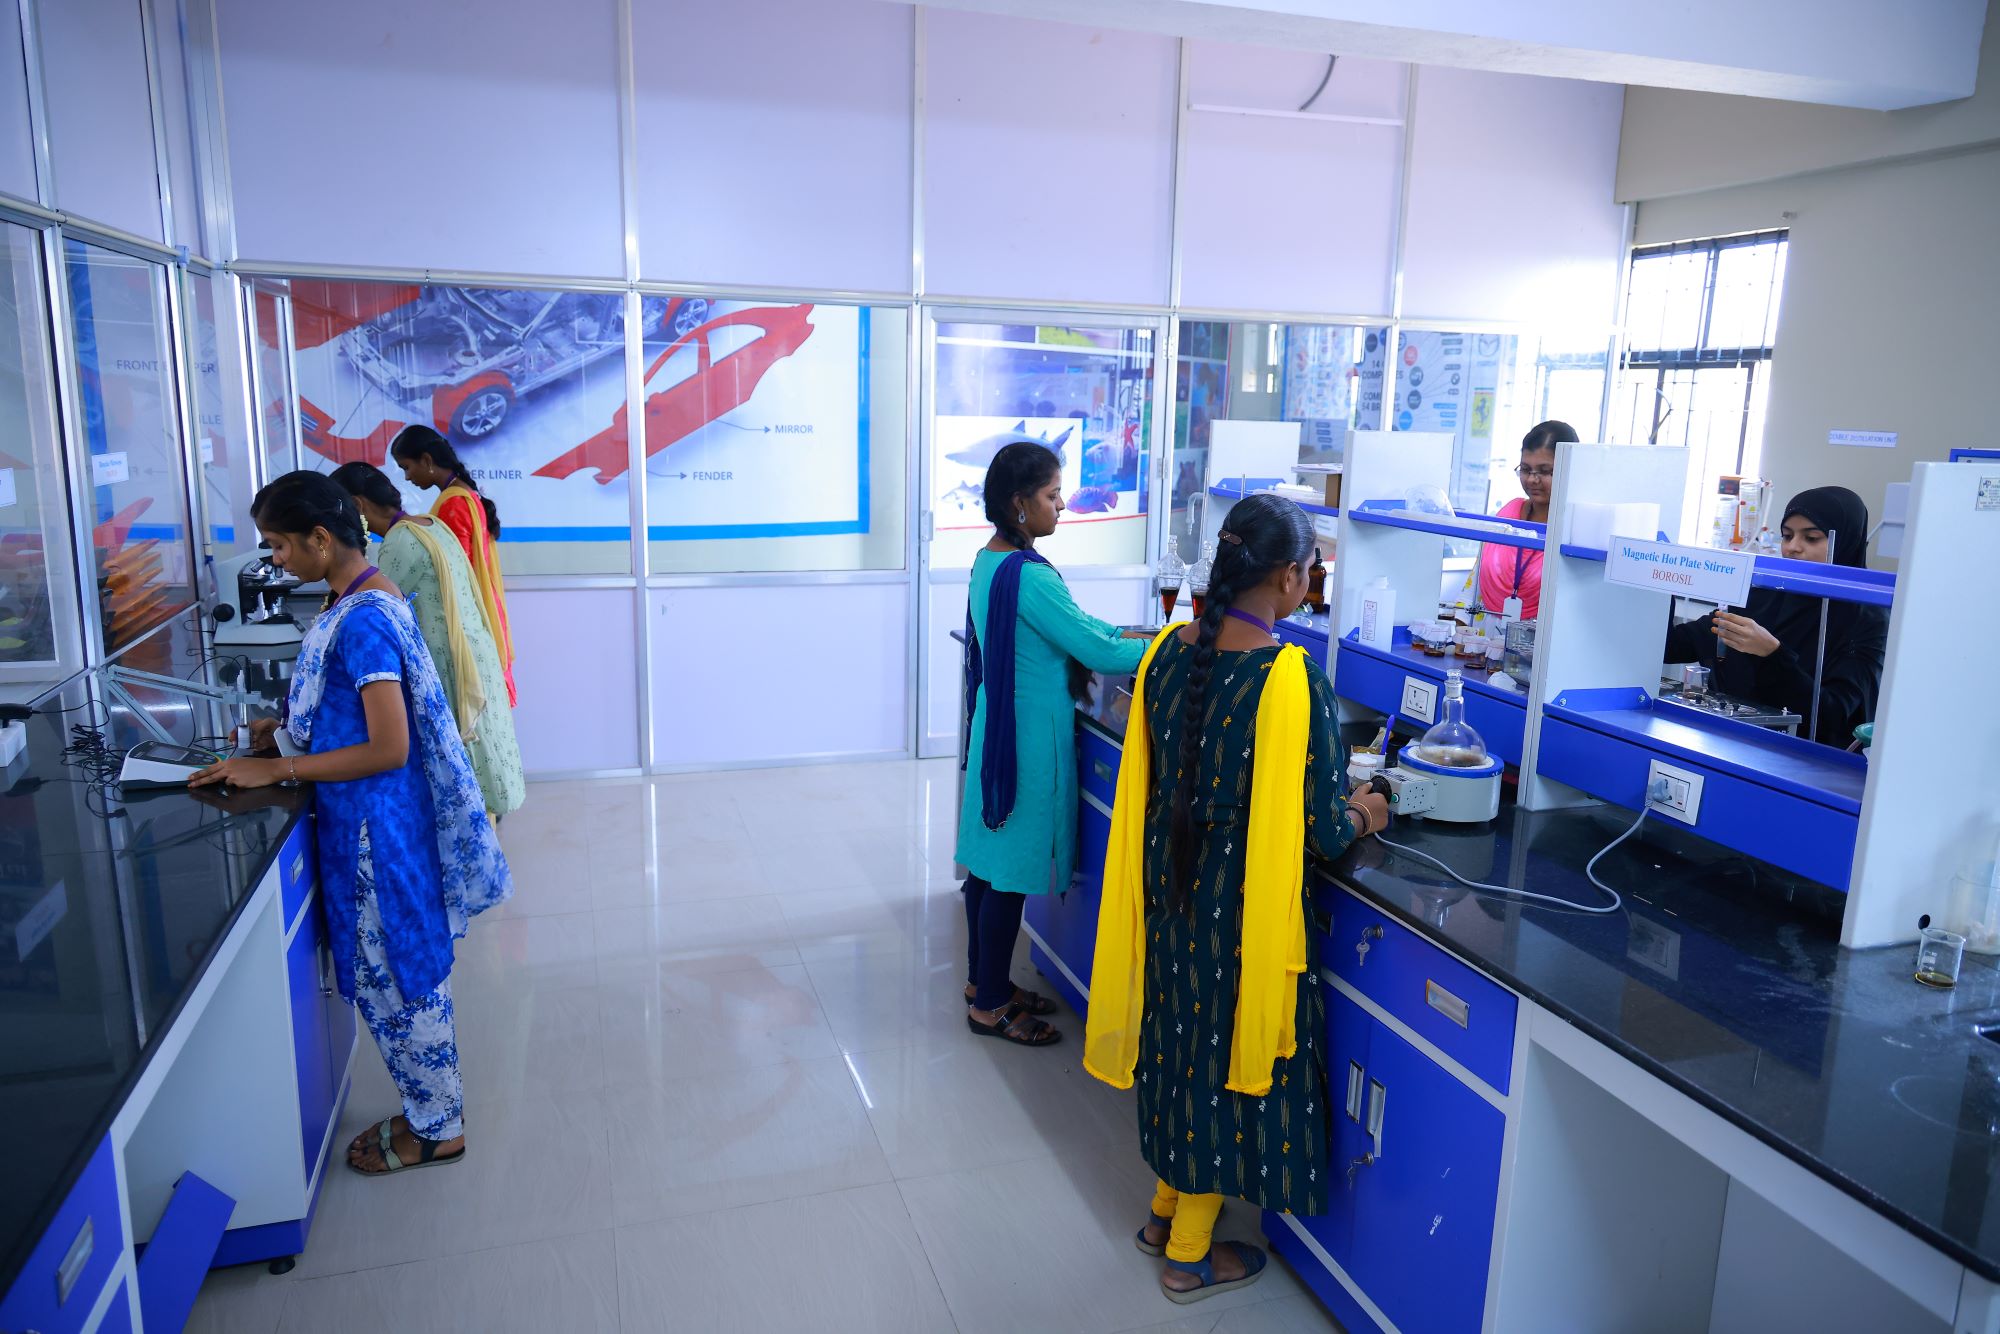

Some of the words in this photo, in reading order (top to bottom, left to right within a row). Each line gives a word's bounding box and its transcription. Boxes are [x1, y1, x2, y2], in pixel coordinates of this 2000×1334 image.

[116, 359, 159, 372] FRONT
[774, 424, 814, 434] MIRROR
[489, 469, 523, 480] LINER
[692, 471, 734, 481] FENDER
[1622, 547, 1660, 562] Magnetic
[1661, 553, 1678, 566] Hot
[1679, 556, 1702, 569] Plate
[1703, 559, 1736, 575] Stirrer
[1651, 568, 1695, 586] BOROSIL
